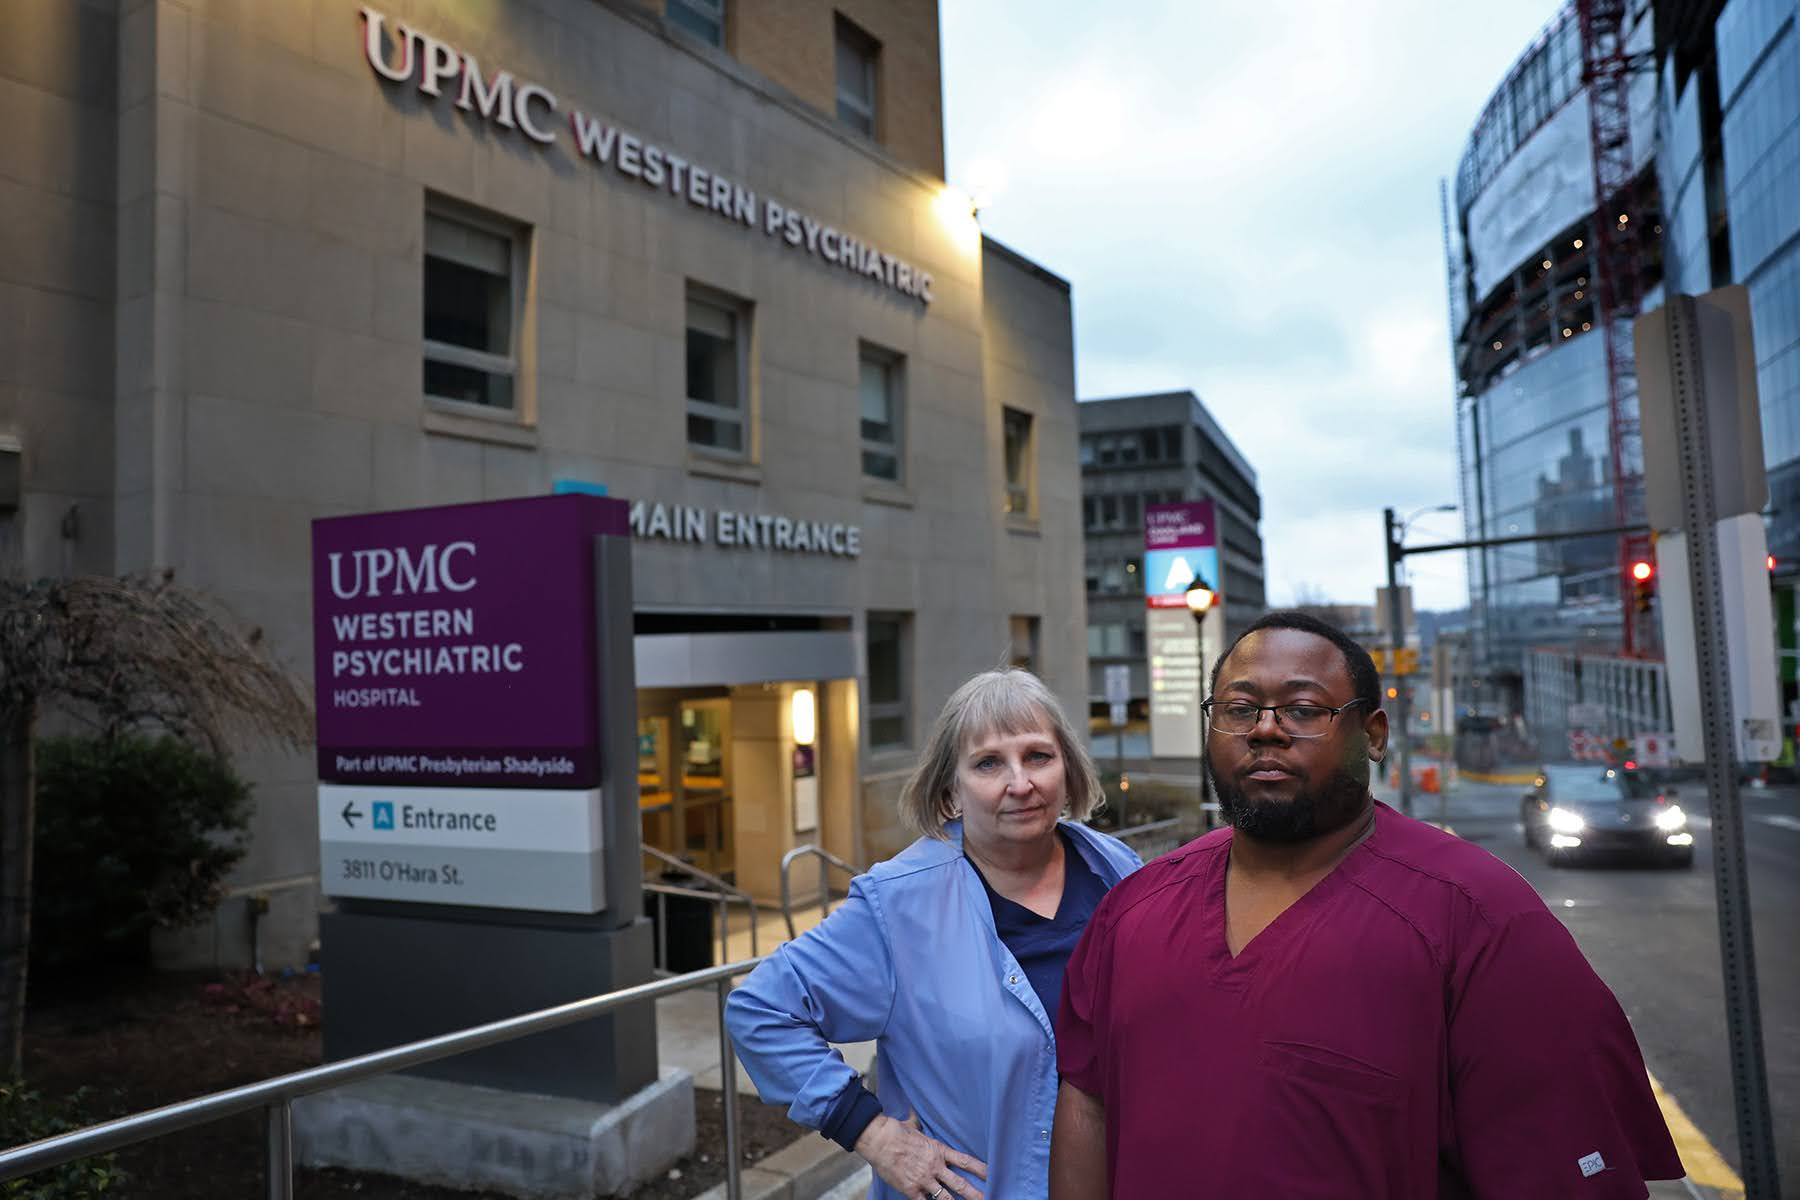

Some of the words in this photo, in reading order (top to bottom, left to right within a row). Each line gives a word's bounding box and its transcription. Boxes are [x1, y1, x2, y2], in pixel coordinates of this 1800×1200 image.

[360, 6, 557, 142] UPMC
[570, 111, 756, 225] WESTERN
[766, 200, 935, 302] PSYCHIATRIC
[717, 510, 861, 555] ENTRANCE
[328, 541, 477, 600] UPMC
[332, 608, 474, 642] WESTERN
[333, 643, 523, 678] PSYCHIATRIC
[333, 688, 421, 708] HOSPITAL
[336, 756, 361, 771] Part
[363, 756, 376, 771] of
[377, 757, 417, 772] UPMC
[419, 757, 502, 776] Presbyterian
[504, 756, 575, 777] Shadyside
[376, 807, 389, 824] A
[402, 805, 496, 832] Entrance
[342, 859, 375, 879] 3811
[379, 861, 438, 883] O'Hara
[442, 864, 464, 886] St.
